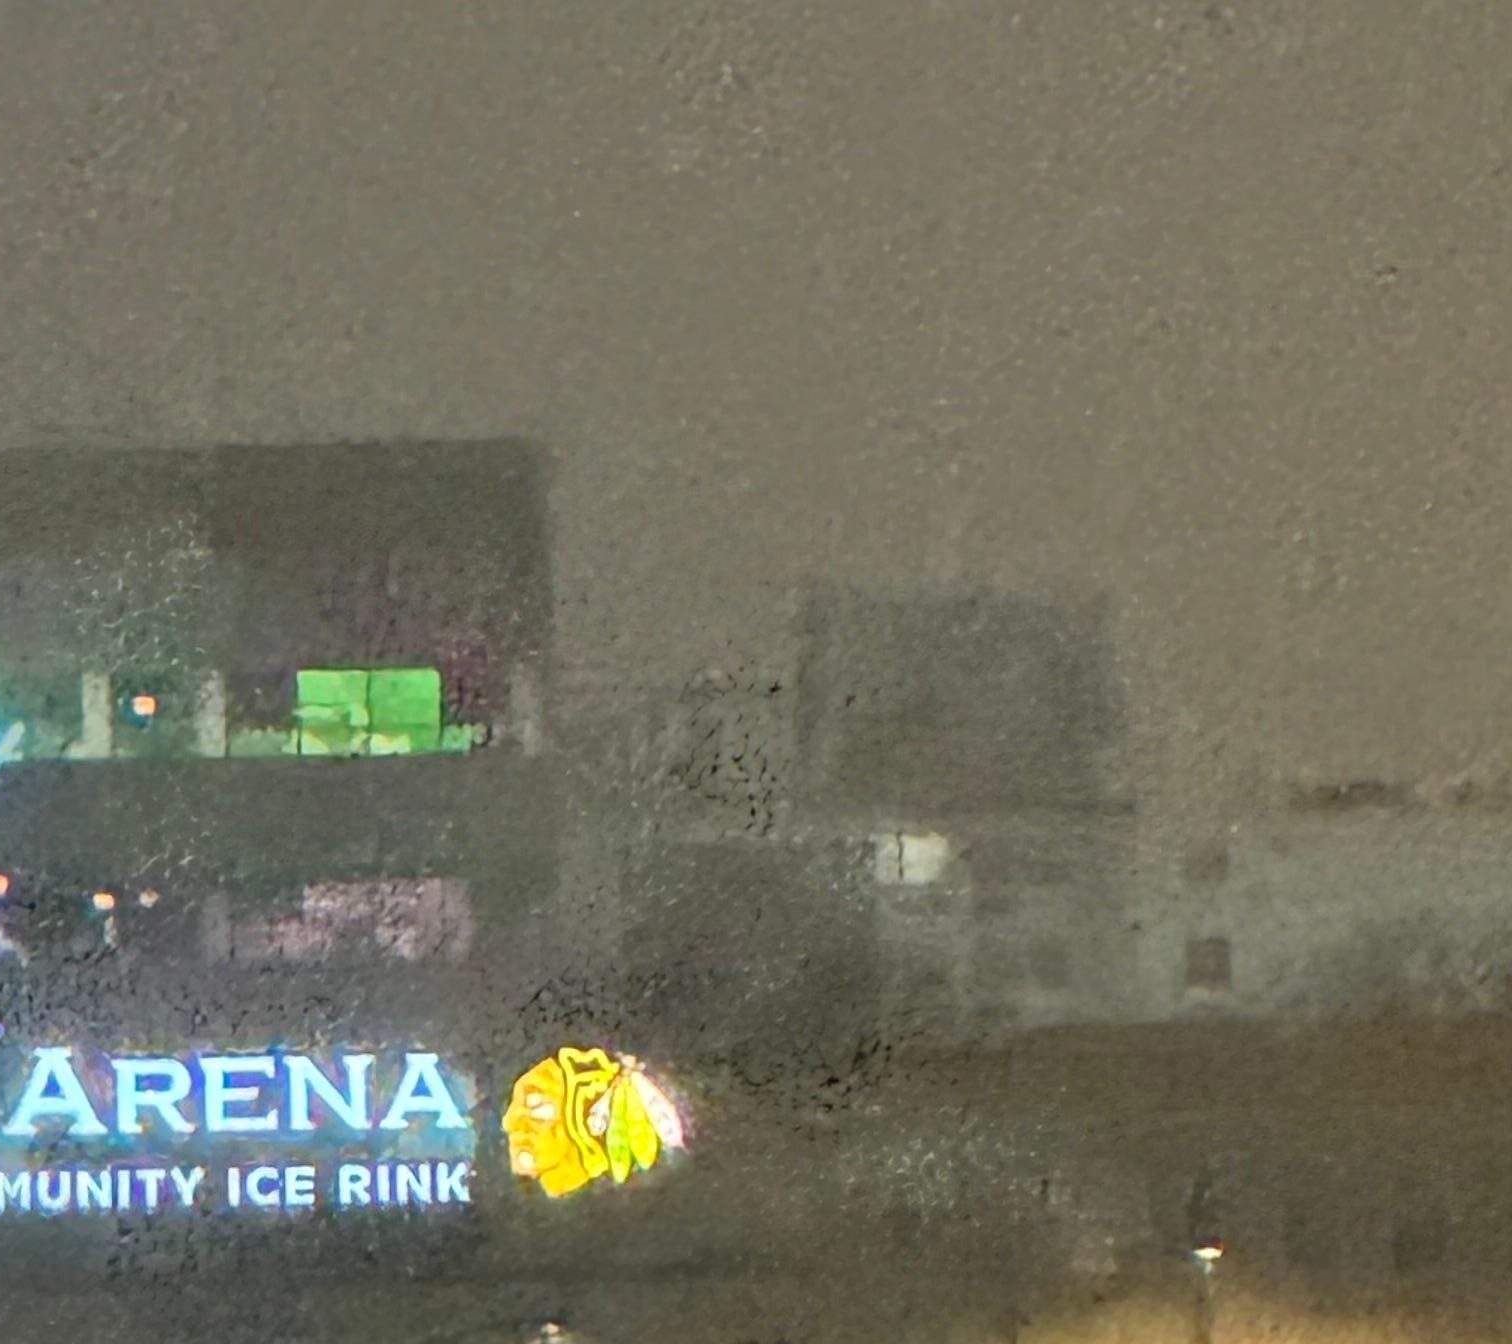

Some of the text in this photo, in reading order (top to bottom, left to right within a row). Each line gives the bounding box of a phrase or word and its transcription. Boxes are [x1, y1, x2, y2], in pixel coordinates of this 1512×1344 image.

[1, 1046, 472, 1136] ARENA
[226, 1164, 317, 1208] ICE
[338, 1161, 472, 1206] RINK
